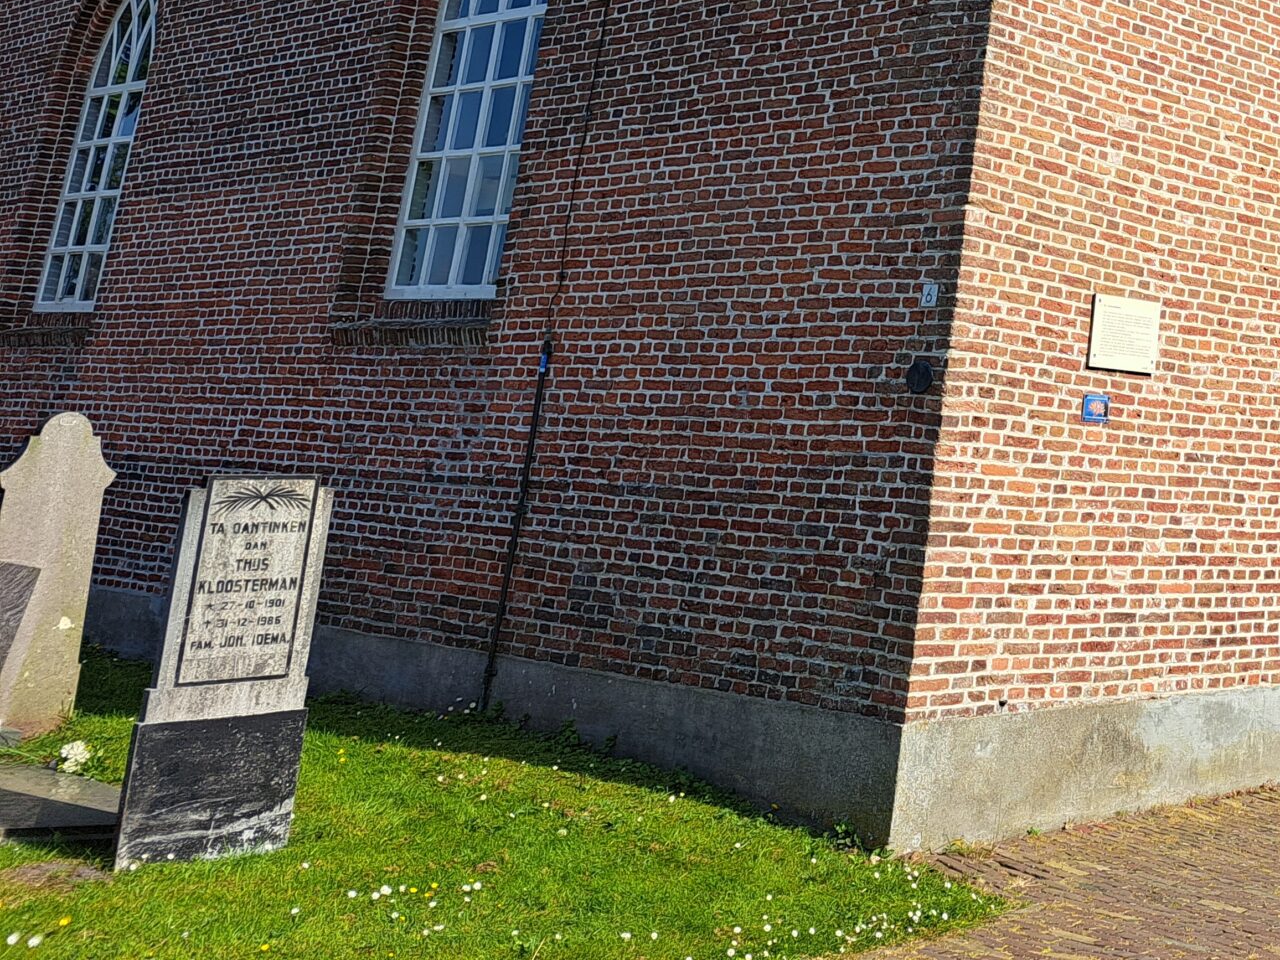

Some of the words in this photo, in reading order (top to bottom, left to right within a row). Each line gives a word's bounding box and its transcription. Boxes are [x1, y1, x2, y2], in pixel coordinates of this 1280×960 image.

[925, 287, 933, 303] 6
[210, 522, 225, 534] TA
[233, 520, 306, 534] OANTINKEN
[198, 577, 297, 594] KLOOSTERMAN
[190, 640, 214, 651] FAM.
